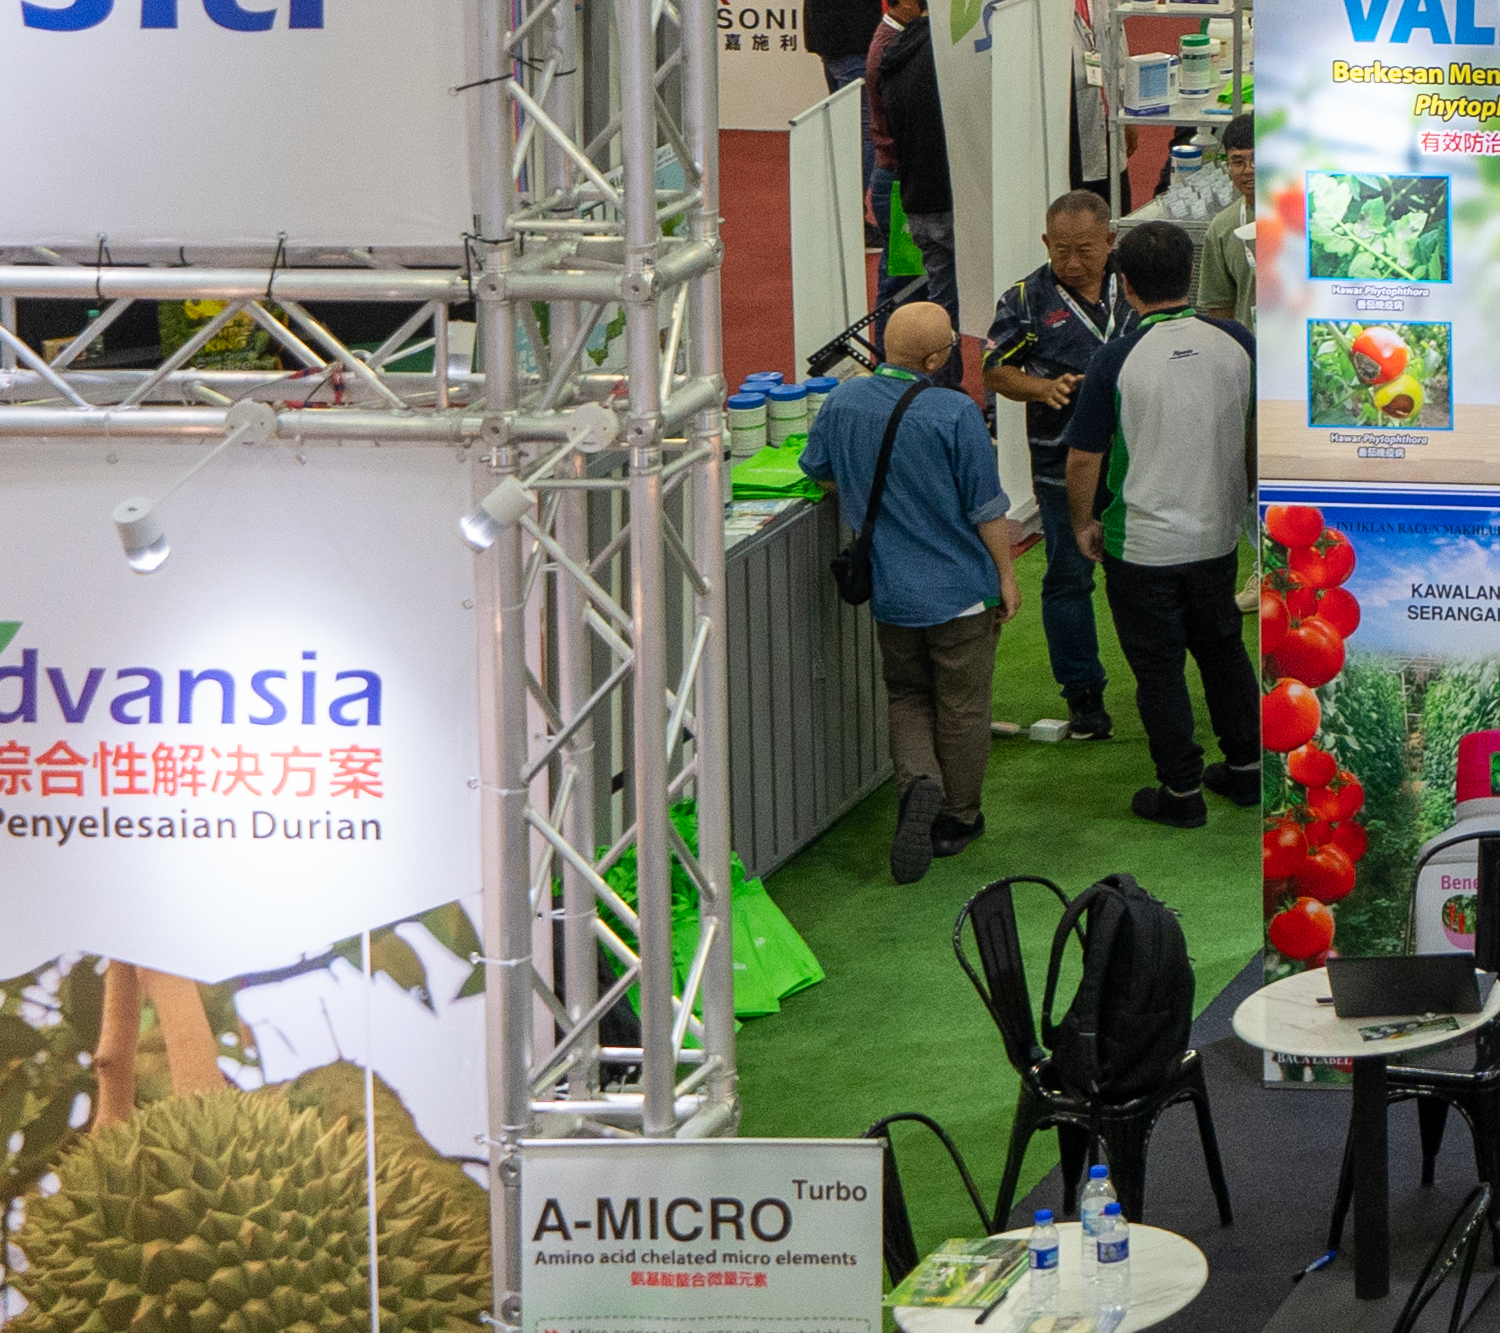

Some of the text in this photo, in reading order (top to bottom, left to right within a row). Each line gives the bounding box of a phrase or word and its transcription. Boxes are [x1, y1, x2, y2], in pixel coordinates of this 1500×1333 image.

[725, 34, 797, 51] 嘉施利
[1333, 60, 1444, 85] Berkesan
[249, 809, 383, 841] Durian
[791, 1179, 868, 1202] Turbo
[532, 1196, 794, 1243] A-MICRO
[535, 1249, 858, 1266] Amino acid chelated micro elements
